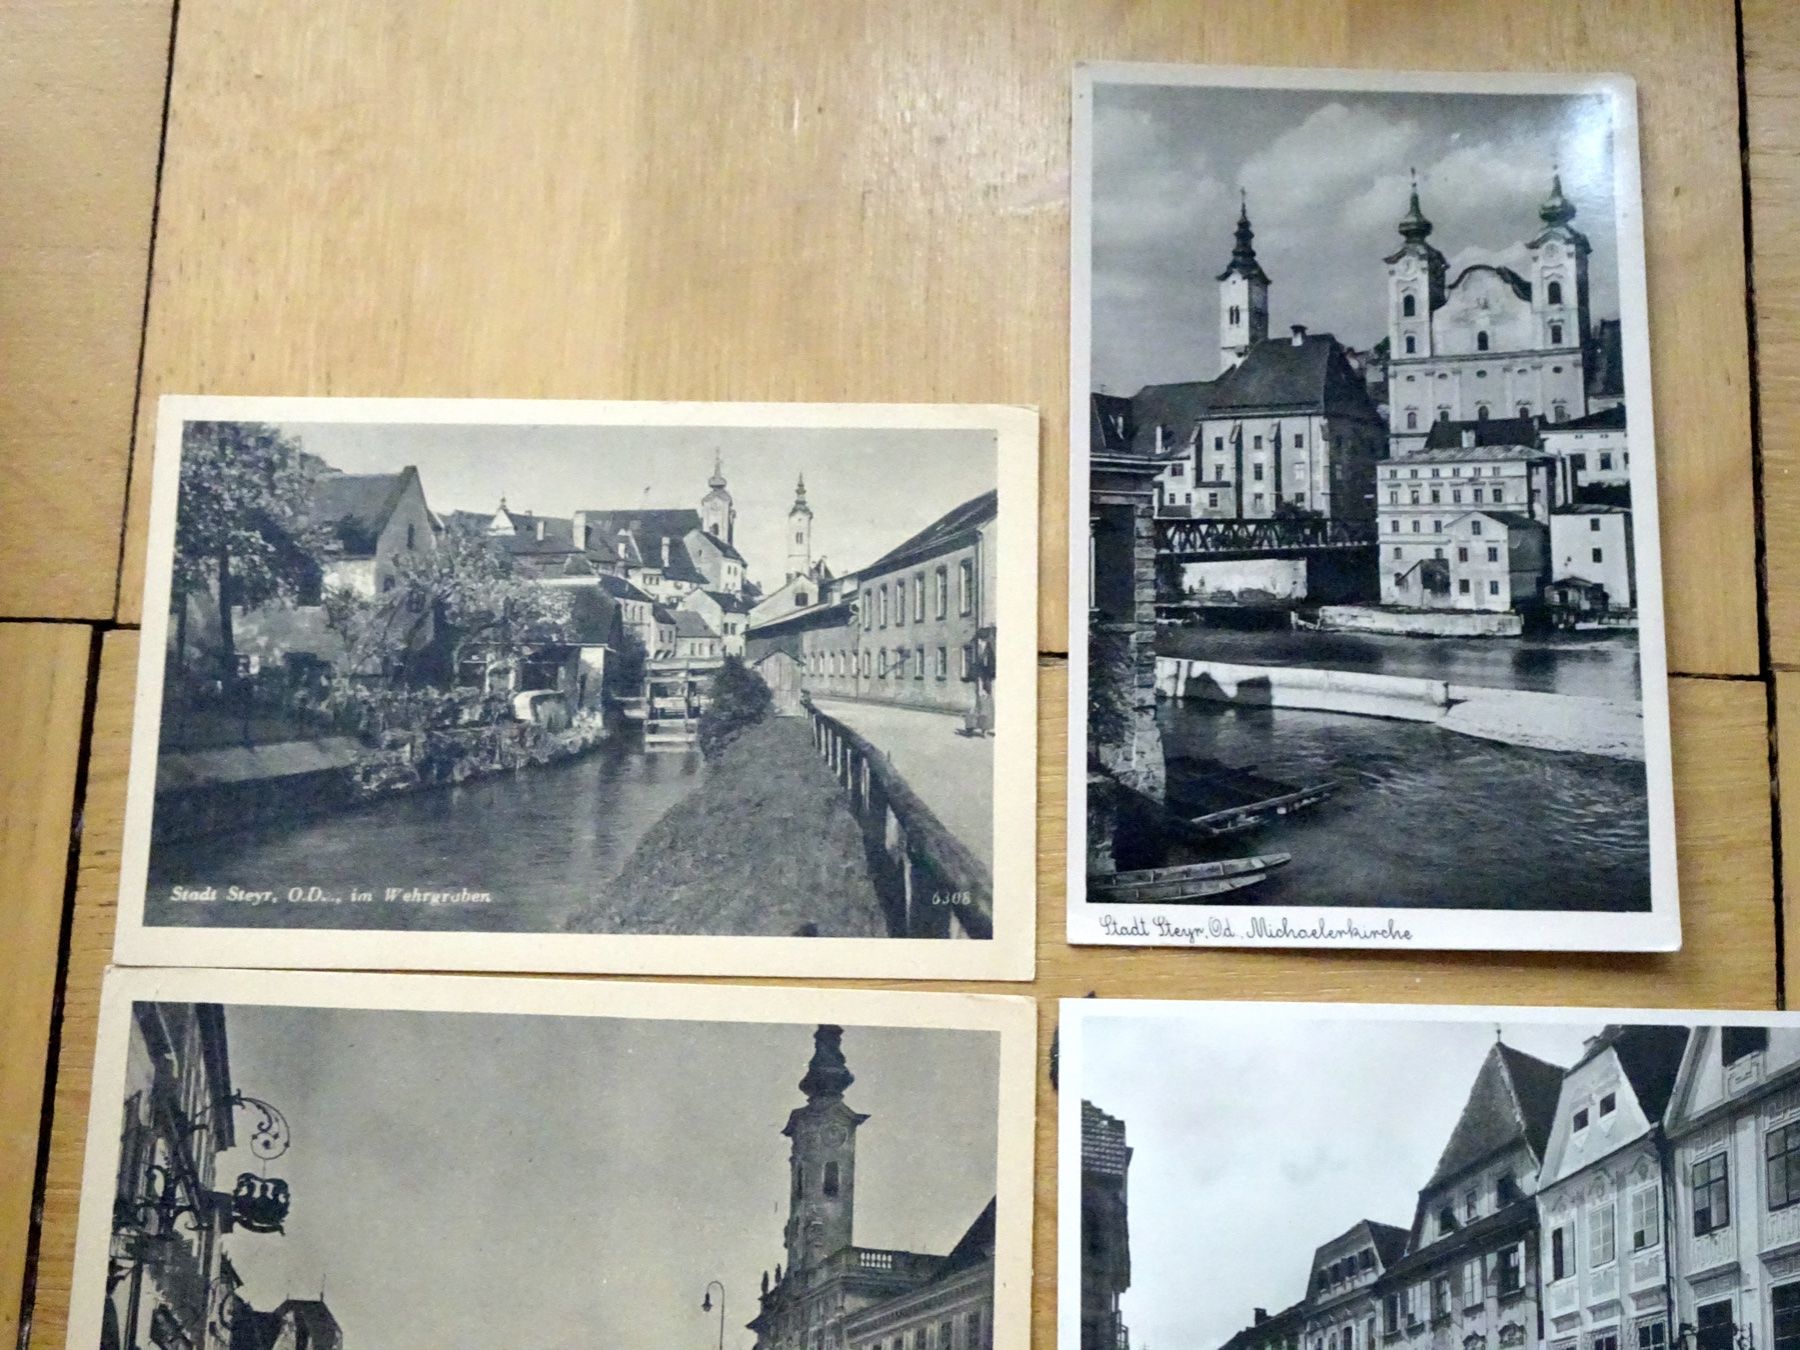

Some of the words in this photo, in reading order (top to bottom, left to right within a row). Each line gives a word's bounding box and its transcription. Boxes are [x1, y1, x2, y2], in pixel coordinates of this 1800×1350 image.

[170, 885, 217, 901] Stadt
[351, 888, 373, 902] im
[385, 887, 492, 906] Wehrgraben
[932, 890, 971, 905] 6308
[1099, 914, 1149, 937] Stadt
